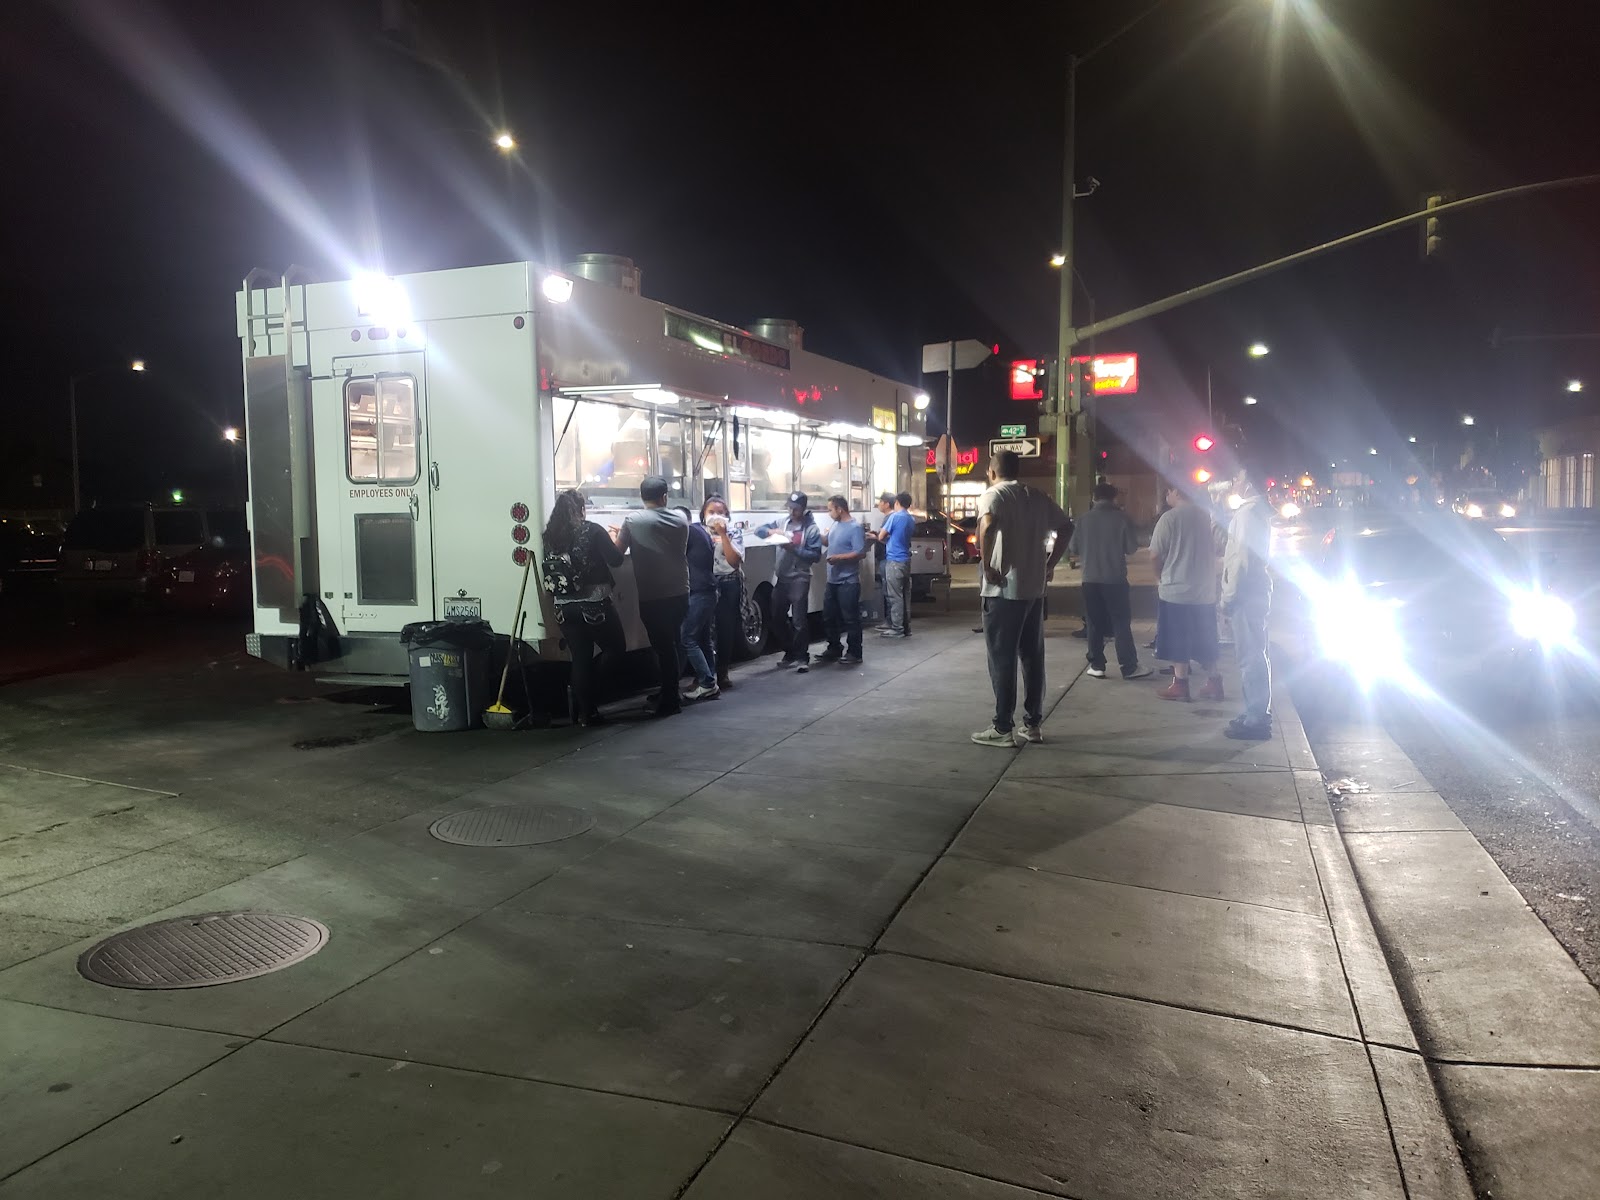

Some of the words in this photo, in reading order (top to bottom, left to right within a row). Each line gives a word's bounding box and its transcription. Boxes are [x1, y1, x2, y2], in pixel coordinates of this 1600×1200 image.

[1010, 444, 1023, 452] WAY
[350, 489, 393, 498] EMPLOYEES
[396, 488, 414, 498] ONLY
